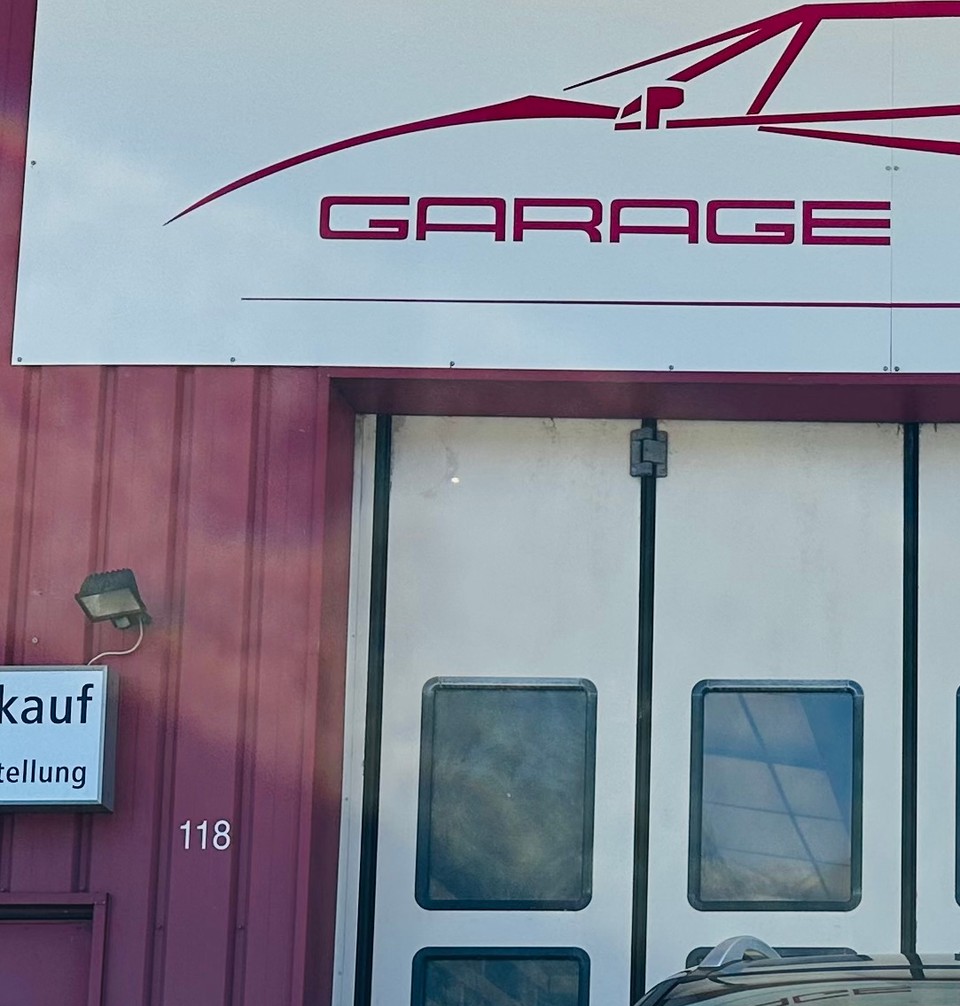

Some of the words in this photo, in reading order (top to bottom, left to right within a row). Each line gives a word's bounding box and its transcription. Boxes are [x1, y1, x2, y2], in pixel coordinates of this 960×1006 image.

[319, 195, 891, 246] GARAGE
[0, 683, 94, 724] kauf
[180, 819, 231, 851] 118
